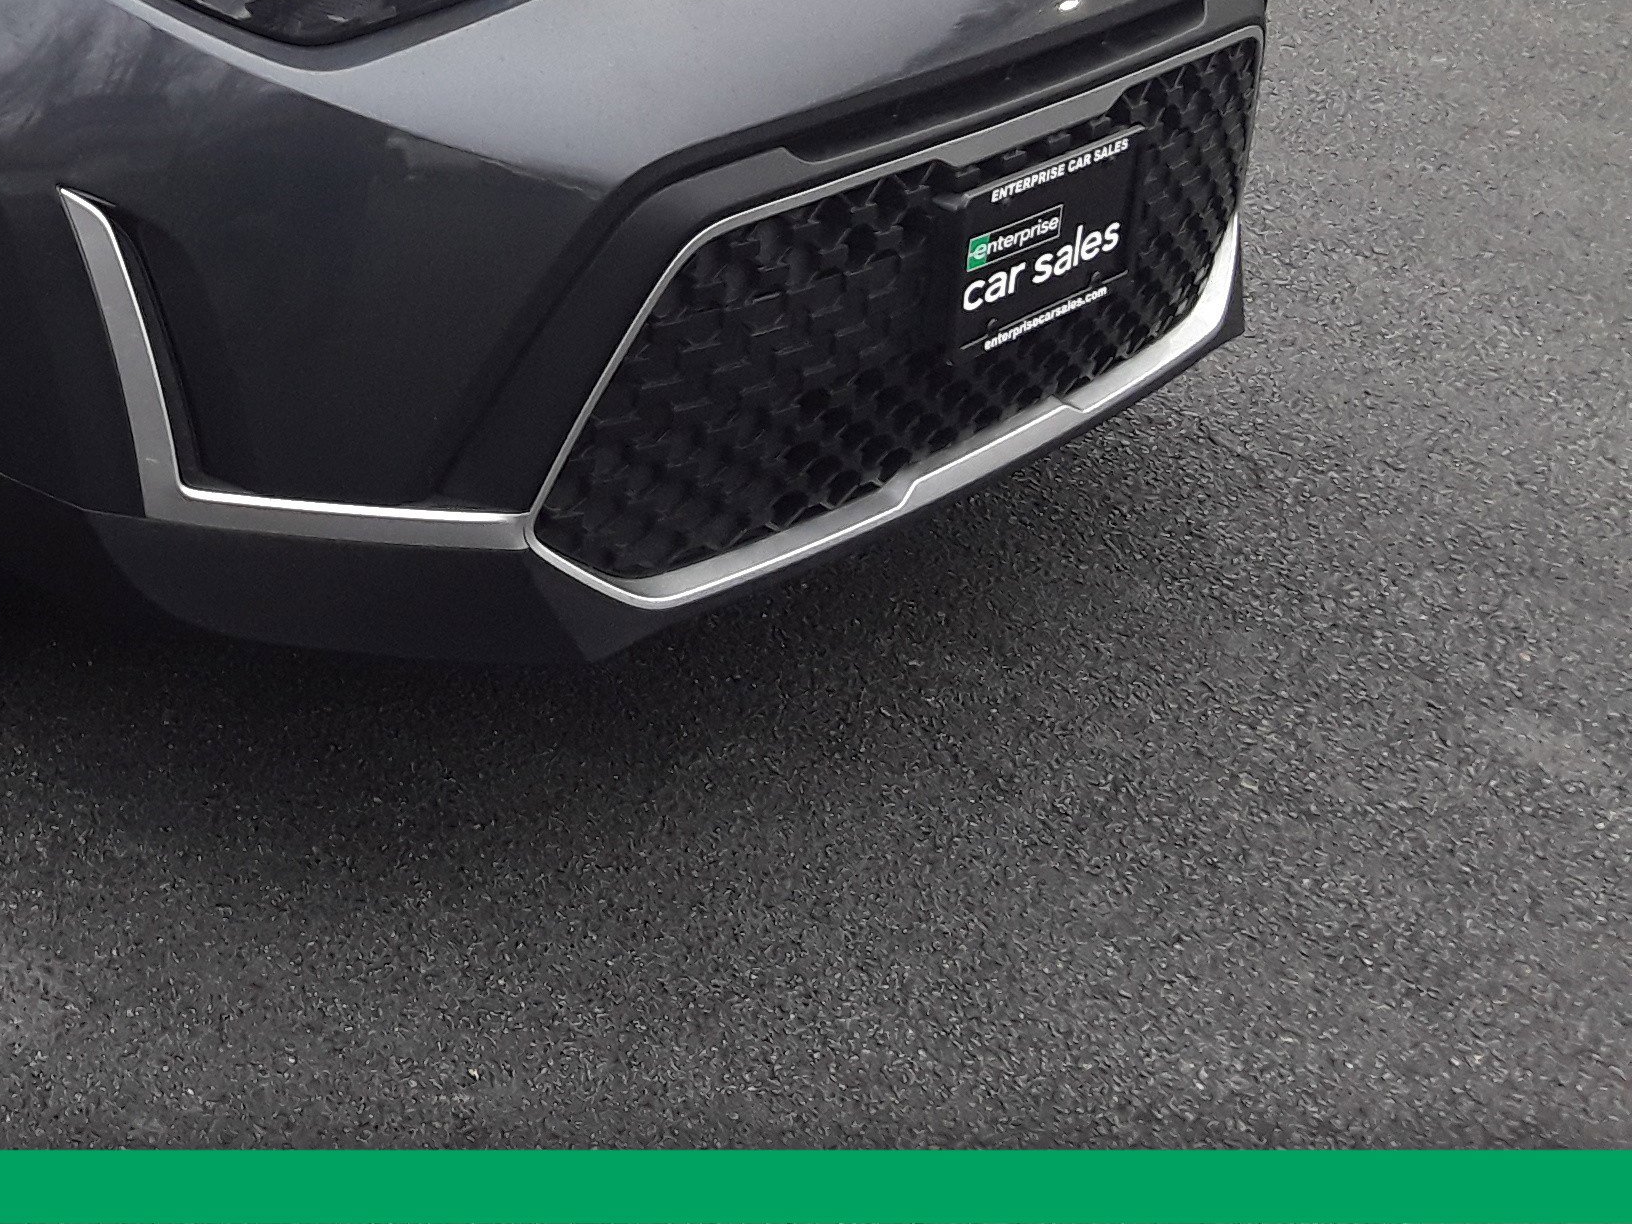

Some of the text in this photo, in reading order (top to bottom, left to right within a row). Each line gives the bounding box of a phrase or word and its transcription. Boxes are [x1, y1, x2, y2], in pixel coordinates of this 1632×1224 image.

[991, 139, 1129, 203] ENTERPRISE CAR SALES
[963, 222, 1121, 311] car sales
[971, 216, 1059, 259] enterprise
